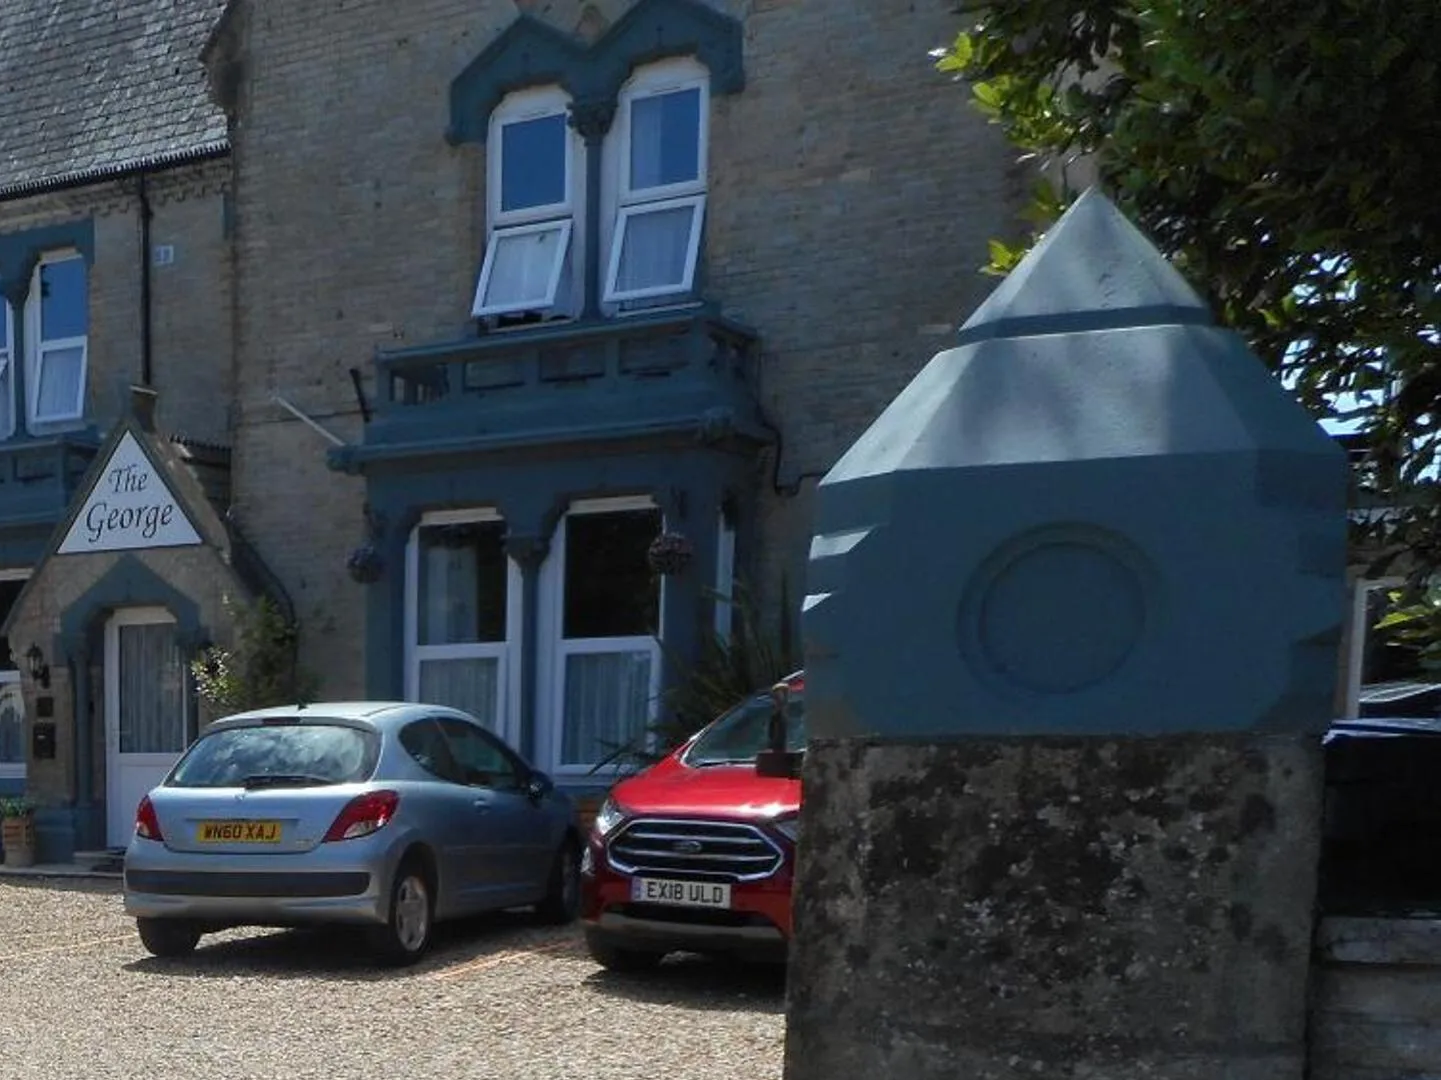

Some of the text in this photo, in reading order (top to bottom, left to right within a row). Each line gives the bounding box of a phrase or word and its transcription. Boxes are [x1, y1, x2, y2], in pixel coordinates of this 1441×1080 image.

[109, 464, 148, 493] The
[86, 502, 173, 543] George
[204, 823, 277, 840] WN60 XAJ
[646, 881, 724, 904] EX18 ULD
